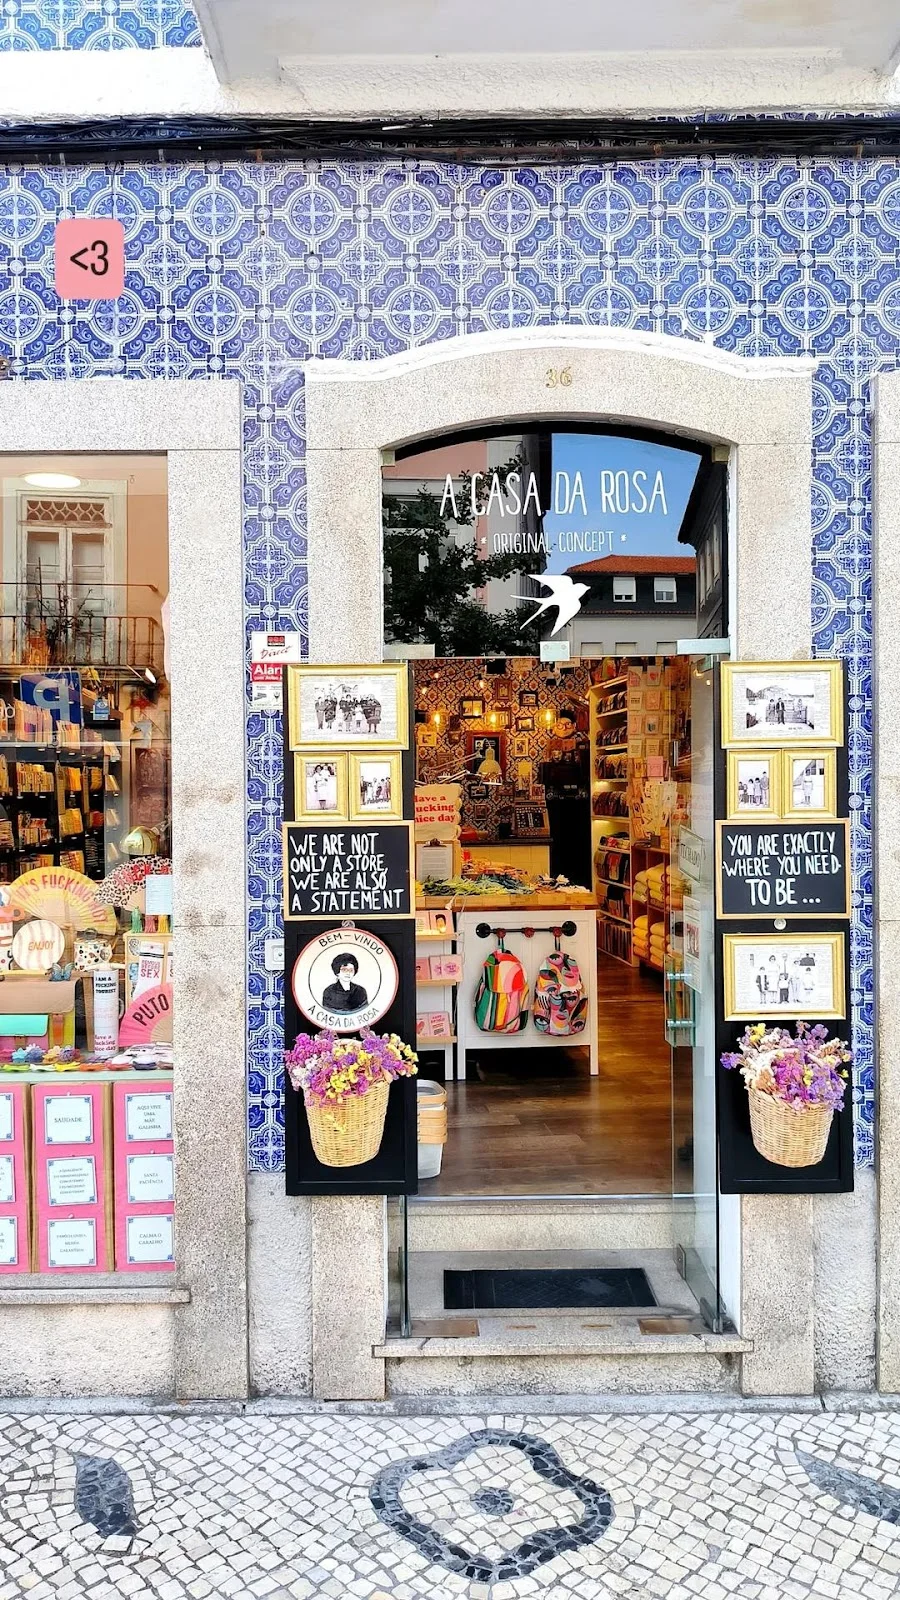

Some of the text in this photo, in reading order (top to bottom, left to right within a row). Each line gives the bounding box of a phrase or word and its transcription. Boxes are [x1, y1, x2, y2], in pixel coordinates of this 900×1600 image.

[545, 366, 572, 388] 36
[439, 470, 668, 518] A CASA DA ROSA
[493, 531, 615, 554] ORIGINAL CONCEPT
[253, 664, 283, 675] Alar
[438, 814, 456, 823] day
[290, 832, 379, 856] WE ARE NOT
[727, 831, 836, 857] YOU ARE EXACTLY
[290, 855, 327, 873] ONLY
[333, 855, 343, 873] A
[777, 857, 801, 875] YOU
[805, 855, 841, 875] NEED
[41, 874, 95, 902] FUCKING
[290, 871, 388, 891] WE ARE ALSO
[745, 878, 771, 906] TO
[775, 877, 797, 906] BE
[291, 889, 405, 913] A STATEMENT
[28, 940, 56, 951] ENJOY
[140, 969, 160, 979] SEX
[132, 993, 170, 1026] PUTO
[307, 1004, 380, 1028] A CASA DA ROSA
